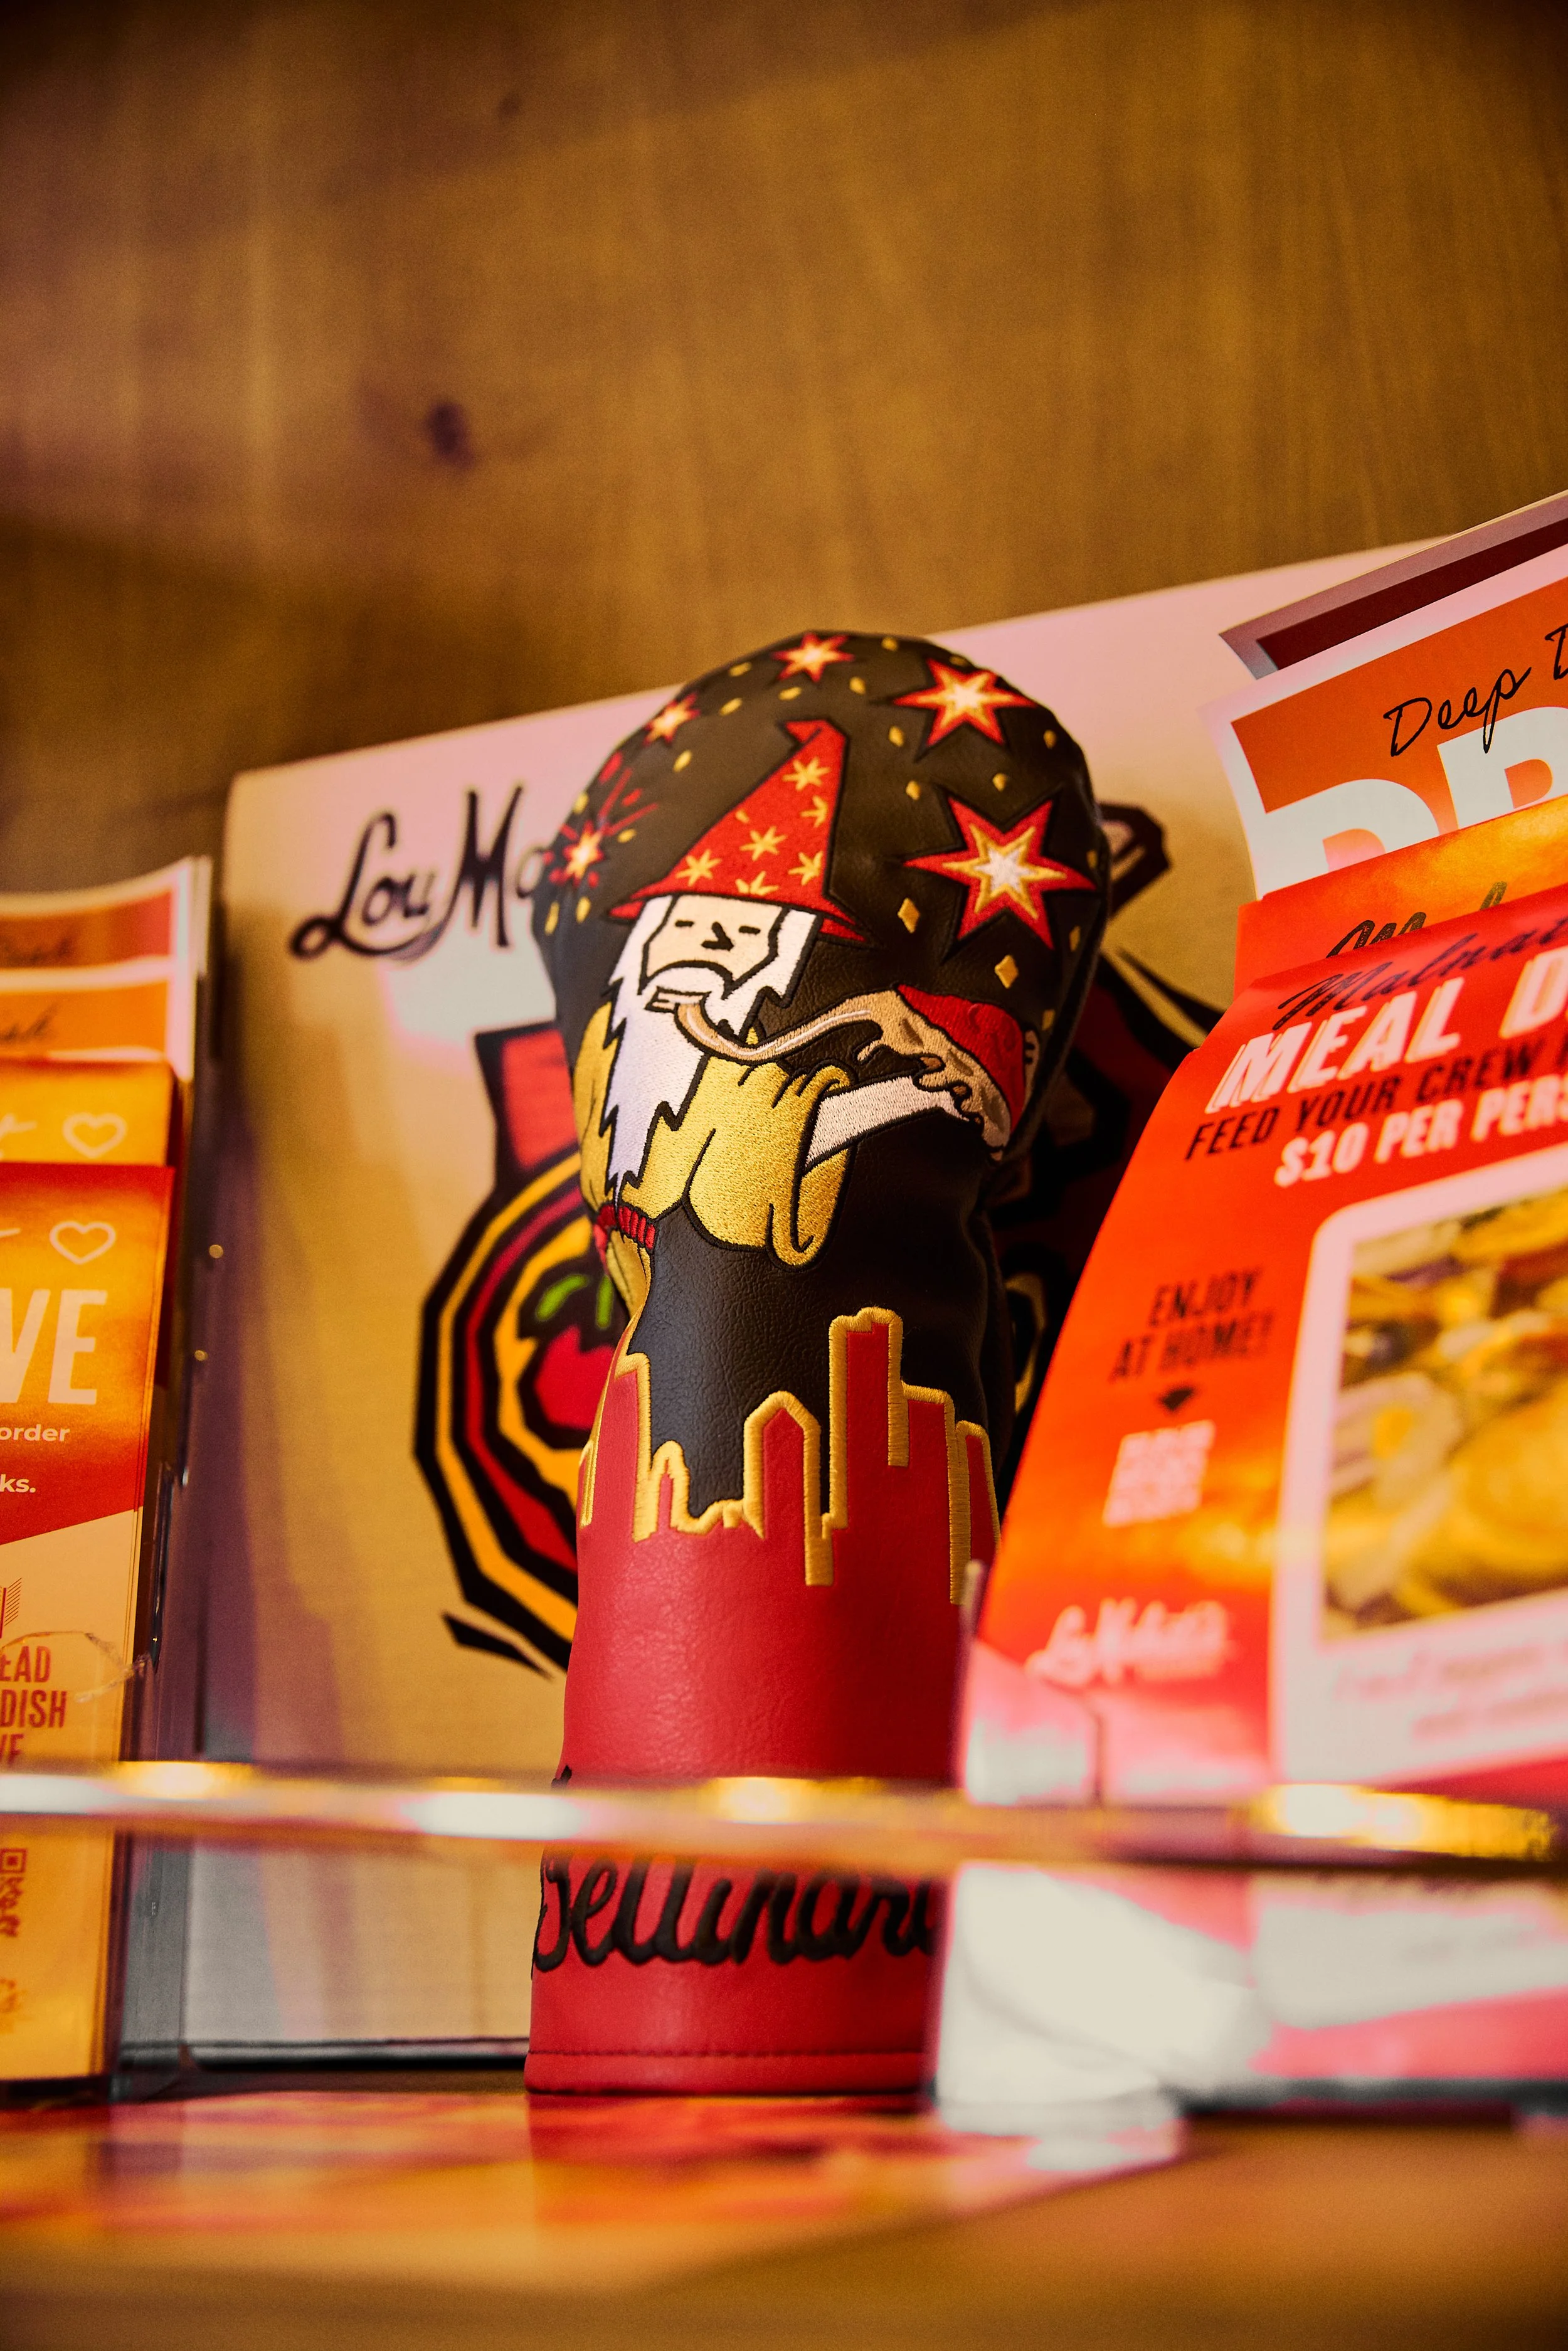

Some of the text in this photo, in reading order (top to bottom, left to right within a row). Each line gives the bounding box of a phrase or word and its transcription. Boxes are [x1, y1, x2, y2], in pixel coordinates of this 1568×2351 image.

[1384, 667, 1532, 757] Deep
[290, 812, 434, 958] Lou
[1204, 945, 1568, 1114] MEAL D
[1184, 1107, 1281, 1160] FEED
[1296, 1075, 1401, 1133] YOUR
[1416, 1038, 1545, 1104] CREW
[1274, 1122, 1369, 1187] $10
[1374, 1099, 1463, 1164] PER
[1149, 1271, 1261, 1329] ENJOY
[1108, 1335, 1153, 1382] AT
[0, 1689, 68, 1729] DISH
